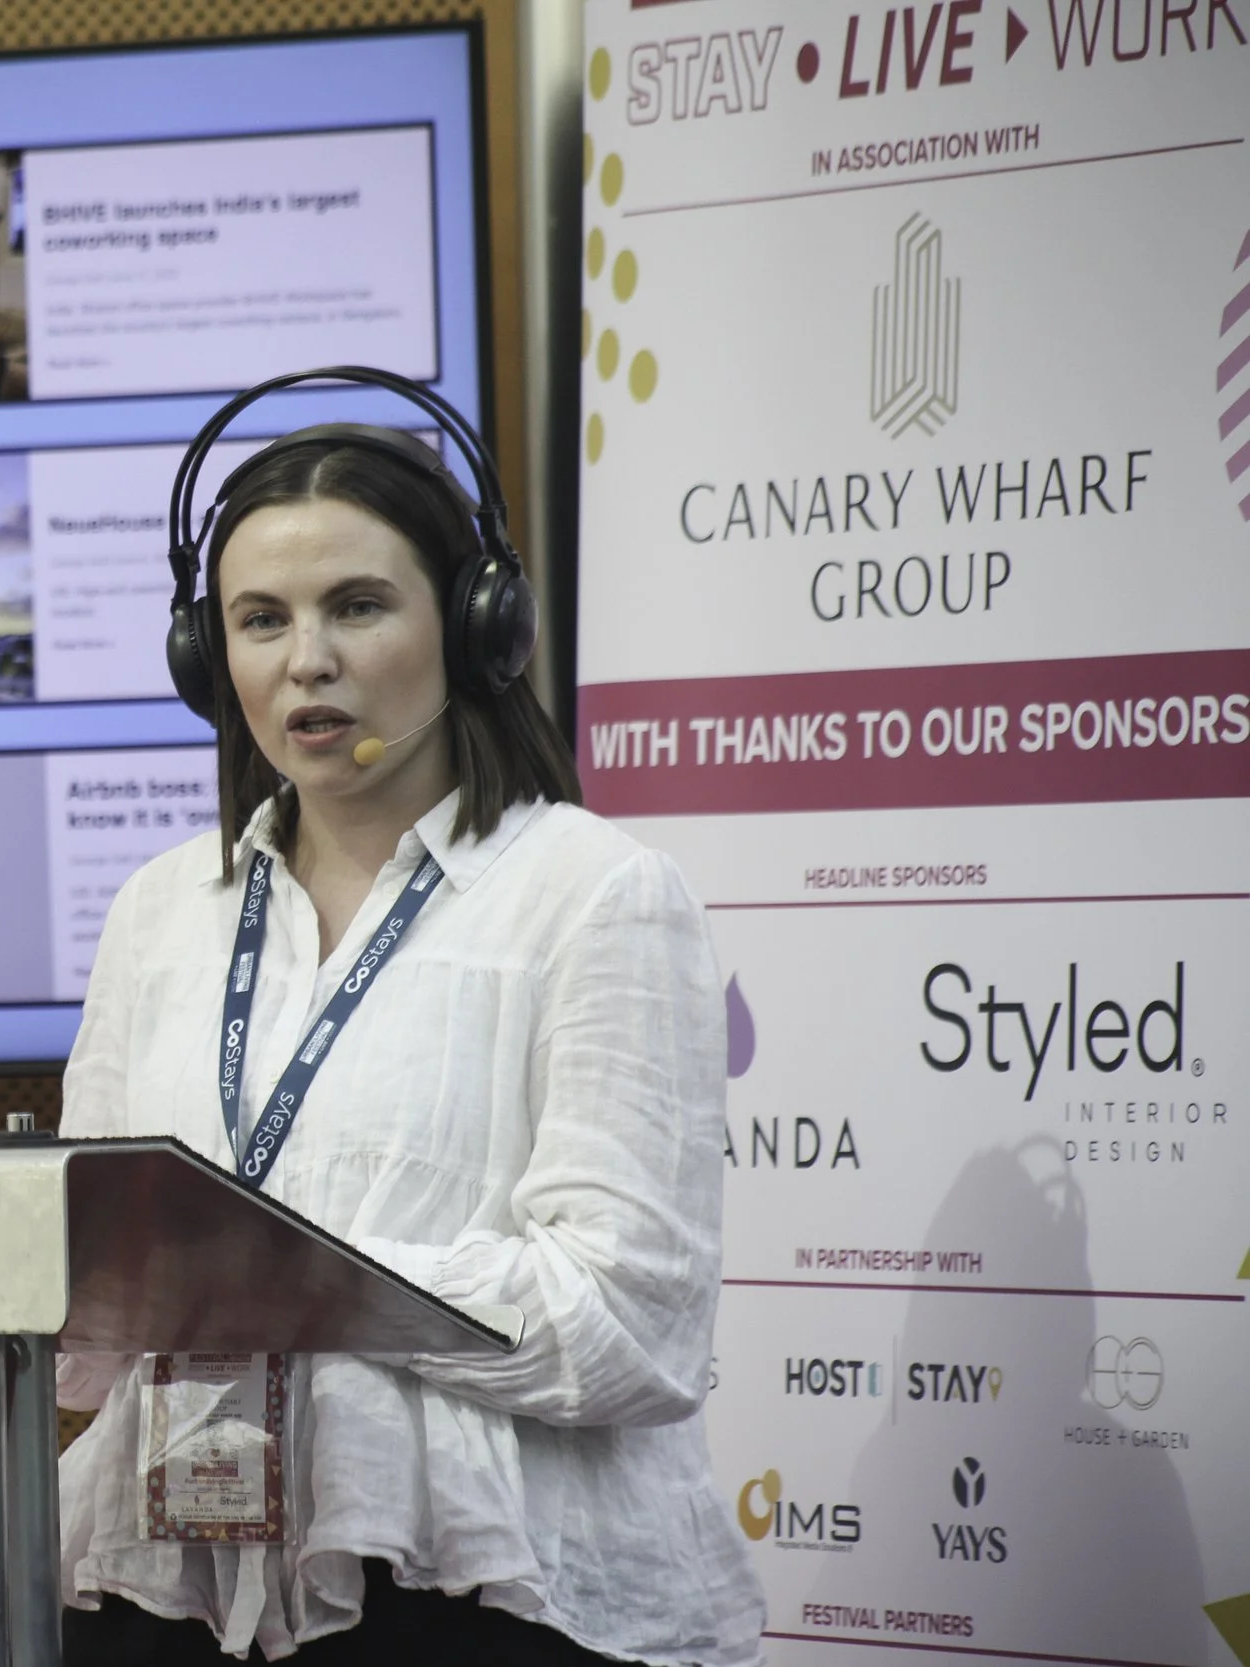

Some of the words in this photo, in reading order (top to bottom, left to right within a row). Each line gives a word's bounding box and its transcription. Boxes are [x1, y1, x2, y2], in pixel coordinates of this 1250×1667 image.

[626, 25, 784, 127] STAY
[838, 4, 982, 100] LIVE
[1050, 0, 1248, 70] WORK
[811, 151, 831, 177] IN
[837, 133, 978, 173] ASSOCIATION
[984, 124, 1040, 155] WITH
[113, 199, 207, 221] launches
[287, 189, 360, 215] largest
[43, 230, 150, 252] coworking
[157, 228, 218, 250] space
[679, 468, 913, 544] CANARY
[935, 450, 1153, 525] WHARF
[810, 551, 1012, 622] GROUP
[590, 720, 678, 770] WITH
[689, 712, 848, 766] THANKS
[857, 710, 910, 758] TO
[921, 704, 1009, 757] OUR
[1019, 694, 1250, 754] SPONSORS
[68, 780, 141, 800] Airbnb
[68, 810, 126, 829] know
[133, 809, 148, 828] it
[154, 809, 172, 827] is
[805, 868, 888, 890] HEADLINE
[892, 865, 987, 888] SPONSORS
[1064, 1102, 1228, 1125] INTERIOR
[1064, 1140, 1186, 1163] DESIGN
[795, 1248, 813, 1269] IN
[817, 1248, 933, 1273] PARTNERSHIP
[936, 1252, 983, 1274] WITH
[785, 1358, 864, 1397] HOST
[908, 1362, 988, 1403] STAY
[1064, 1427, 1110, 1445] HOUSE
[1132, 1430, 1189, 1449] GARDEN
[775, 1501, 861, 1543] IMS
[933, 1523, 1008, 1563] YAYS
[802, 1603, 879, 1630] FESTIVAL
[884, 1609, 974, 1638] PARTNERS
